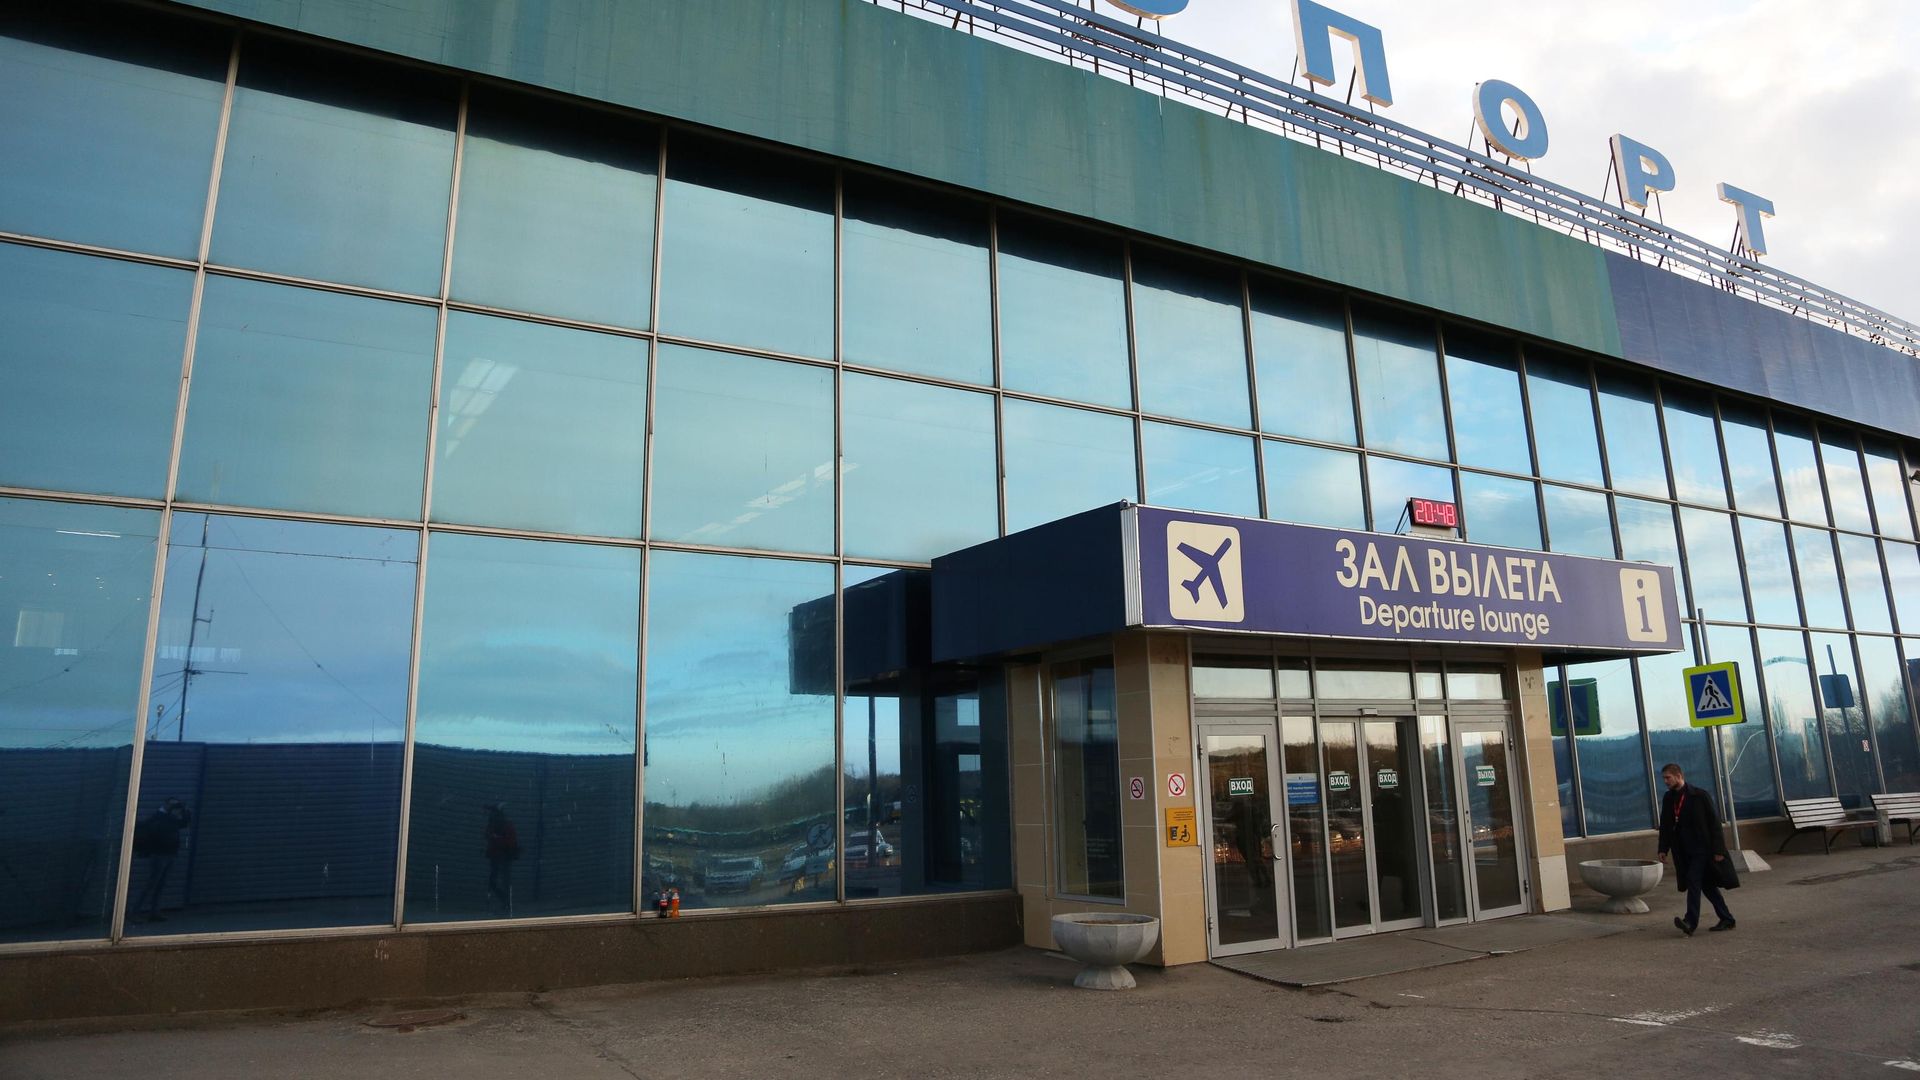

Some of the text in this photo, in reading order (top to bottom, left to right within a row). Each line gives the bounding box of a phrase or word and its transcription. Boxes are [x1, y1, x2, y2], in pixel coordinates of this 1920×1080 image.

[1105, 0, 1775, 257] ПОРТ
[1415, 500, 1456, 526] 20:48
[1335, 538, 1563, 603] ЗАЛ ВЫЛЕТА
[1359, 595, 1550, 641] Departure lounge
[1230, 780, 1253, 792] ВХОД
[1330, 776, 1350, 787] ВХОД
[1379, 773, 1397, 784] ВХОД
